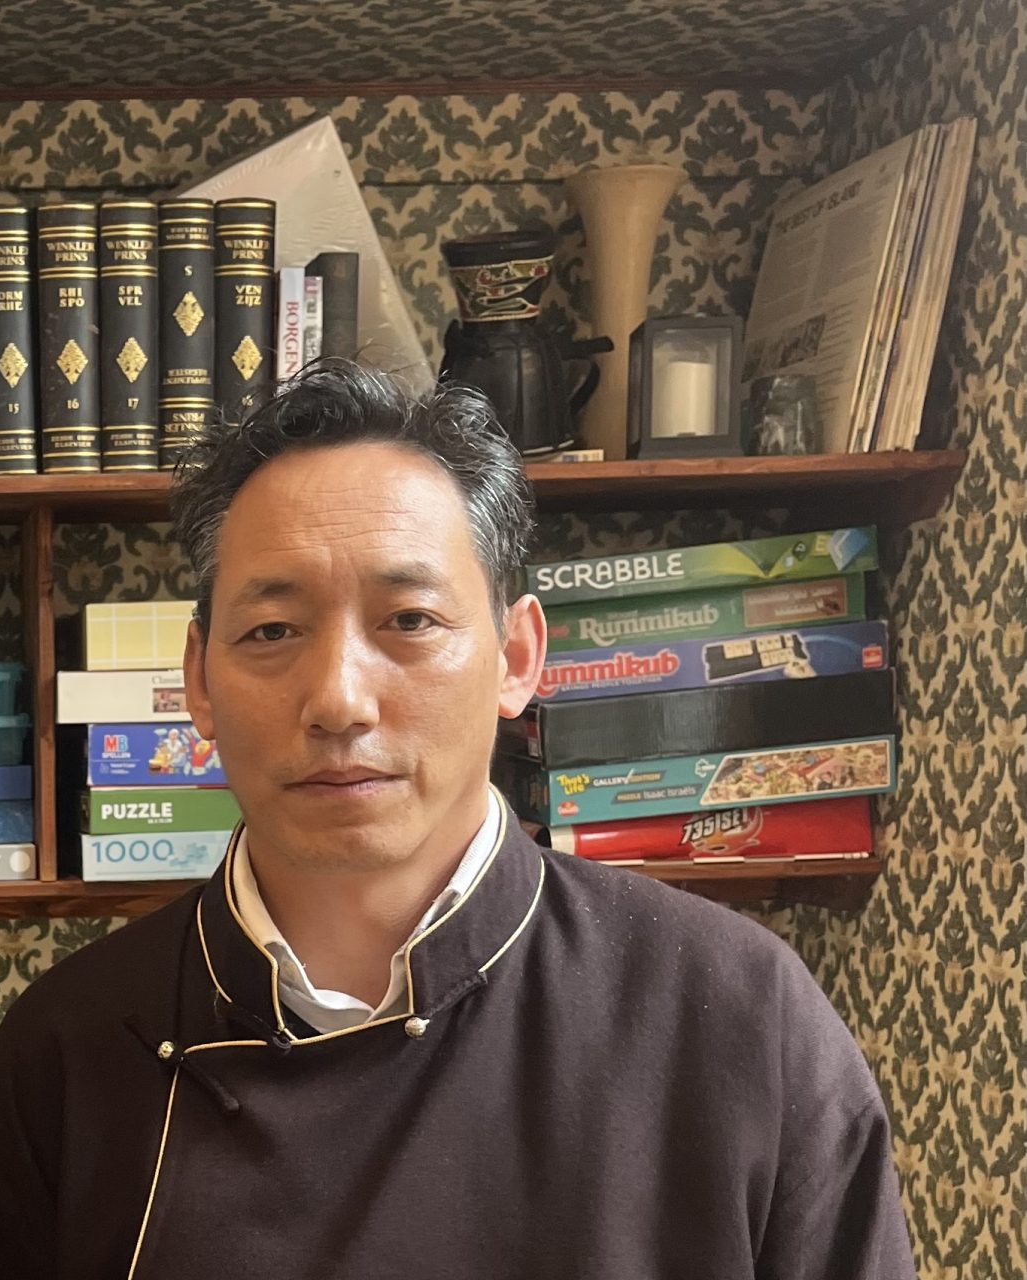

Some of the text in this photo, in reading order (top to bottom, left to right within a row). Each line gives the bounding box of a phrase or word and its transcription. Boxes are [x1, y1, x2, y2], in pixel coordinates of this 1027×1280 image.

[47, 241, 94, 252] WINKLER
[106, 240, 153, 250] WINKLER
[56, 252, 88, 261] PRINS
[114, 251, 147, 260] PRINS
[233, 250, 264, 259] PRINS
[119, 286, 142, 295] SPR
[235, 285, 262, 295] VEN
[60, 298, 84, 307] SPO
[118, 296, 142, 306] VEL
[283, 301, 299, 374] BORGEN
[67, 400, 79, 409] 16
[128, 398, 139, 409] 17
[9, 404, 19, 414] 15
[537, 553, 684, 591] SCRABBLE
[578, 604, 719, 647] Rummikub
[535, 648, 680, 698] ummikub
[104, 734, 128, 752] MB
[101, 802, 174, 820] PUZZLE
[92, 839, 174, 864] 1000
